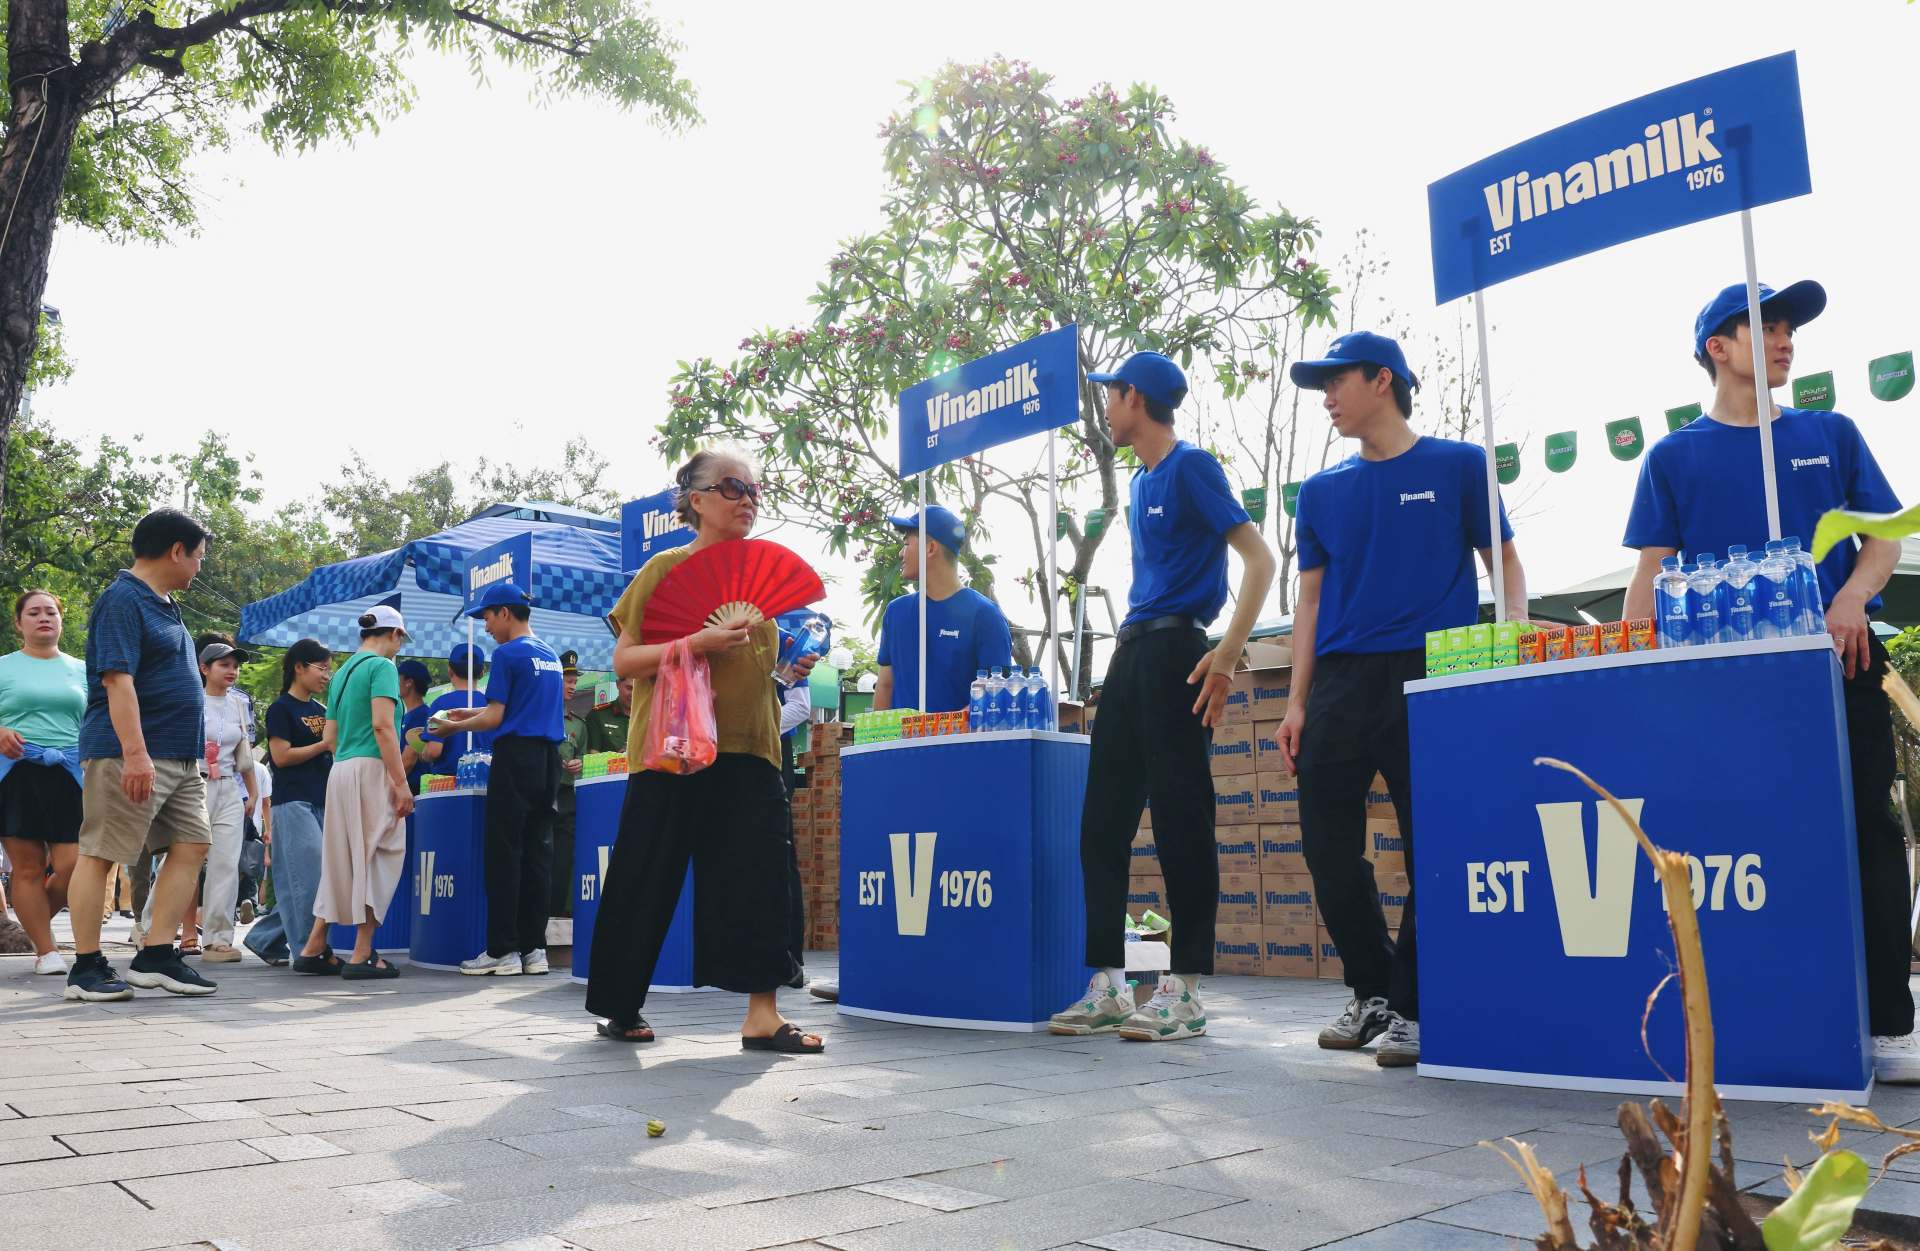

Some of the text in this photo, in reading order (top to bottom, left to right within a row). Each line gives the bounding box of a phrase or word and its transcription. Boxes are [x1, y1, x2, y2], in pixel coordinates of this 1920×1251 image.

[1483, 112, 1723, 232] Vinamilk
[1489, 164, 1725, 256] EST 1976
[926, 362, 1040, 433] Vinamilk
[927, 398, 1040, 449] EST 1976
[1400, 490, 1435, 502] Vinamilk
[643, 509, 688, 540] Vina
[642, 541, 651, 552] EST
[470, 552, 514, 591] Vinamilk
[1575, 625, 1595, 637] SUSU
[1602, 622, 1621, 635] SUSU
[1629, 619, 1650, 632] SUSU
[1520, 632, 1537, 645] SUSU
[1547, 629, 1565, 641] SUSU
[1253, 685, 1291, 701] Vinami
[1258, 739, 1281, 752] Vina
[1260, 788, 1299, 803] Vinamil
[1367, 791, 1393, 804] Vina
[1262, 840, 1302, 853] Vinamil
[1373, 832, 1404, 852] Vinam
[421, 851, 436, 916] V
[434, 874, 454, 898] 1976
[859, 832, 993, 937] EST V 1976
[1467, 860, 1530, 914] EST
[1535, 798, 1645, 958] V
[582, 873, 596, 901] EST
[1265, 891, 1313, 905] Vinamilk
[1216, 941, 1261, 956] Vinamilk
[1266, 942, 1314, 957] Vinamilk
